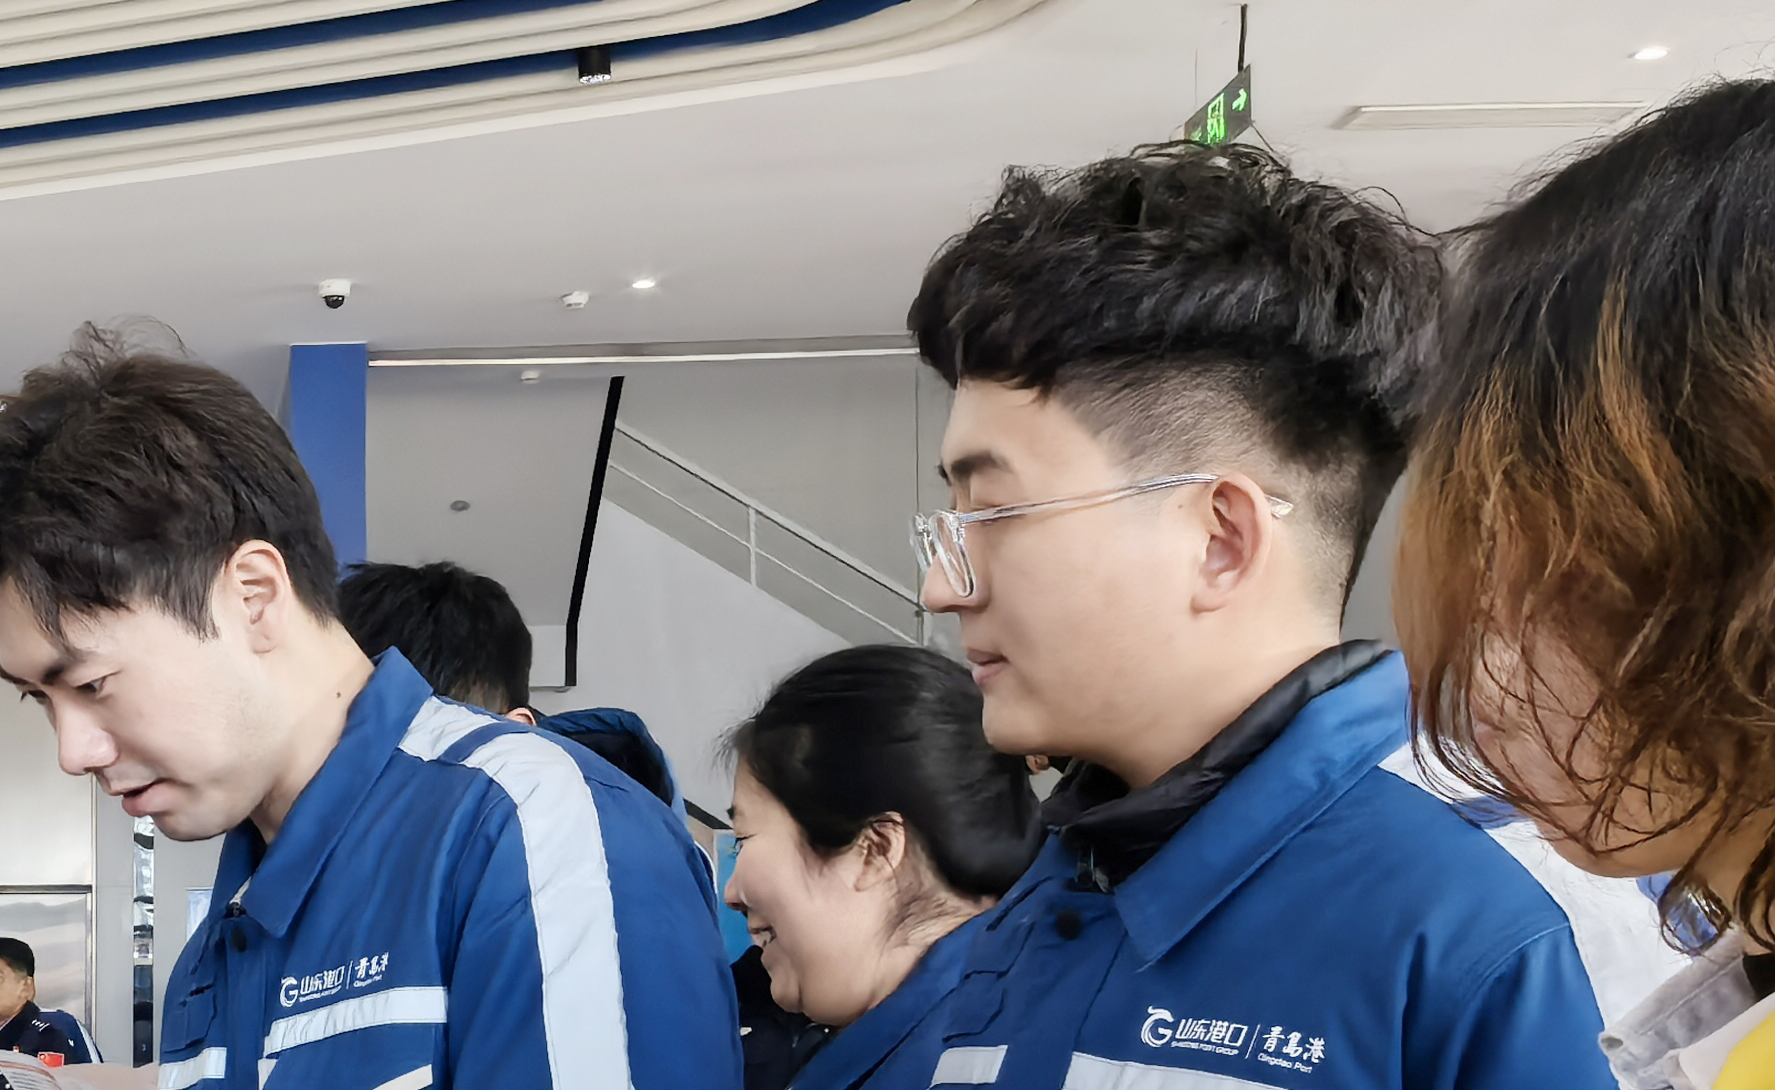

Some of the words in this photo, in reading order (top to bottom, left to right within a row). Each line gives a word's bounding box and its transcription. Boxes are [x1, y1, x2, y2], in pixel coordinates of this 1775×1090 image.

[1174, 1017, 1249, 1047] 山东港口
[1262, 1025, 1326, 1064] 青岛港
[1257, 1052, 1293, 1070] Qingdao
[1293, 1060, 1313, 1075] Port
